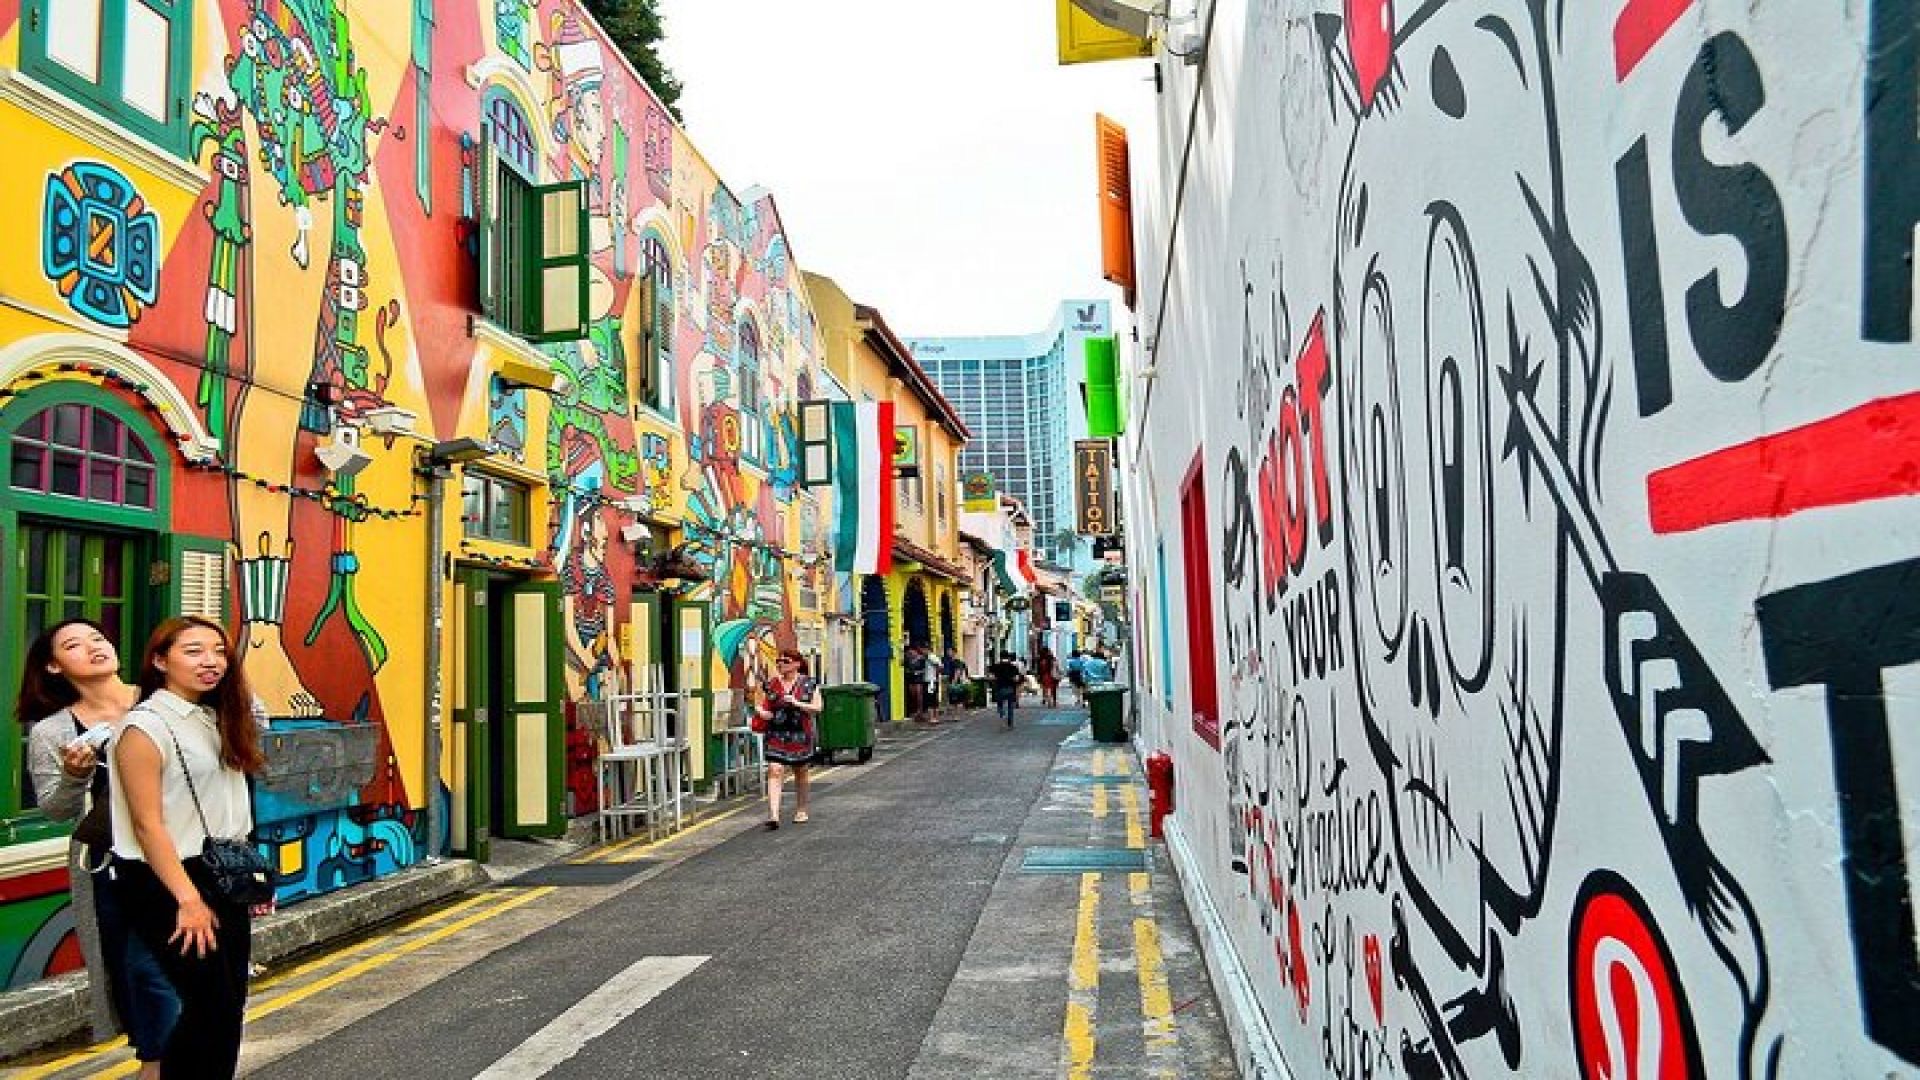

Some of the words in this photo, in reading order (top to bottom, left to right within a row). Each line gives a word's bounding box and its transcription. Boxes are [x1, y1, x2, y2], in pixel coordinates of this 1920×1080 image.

[1614, 30, 1788, 418] IS
[1086, 449, 1102, 534] TATTOO
[1258, 304, 1333, 613] NOT
[1282, 568, 1344, 686] YOUR
